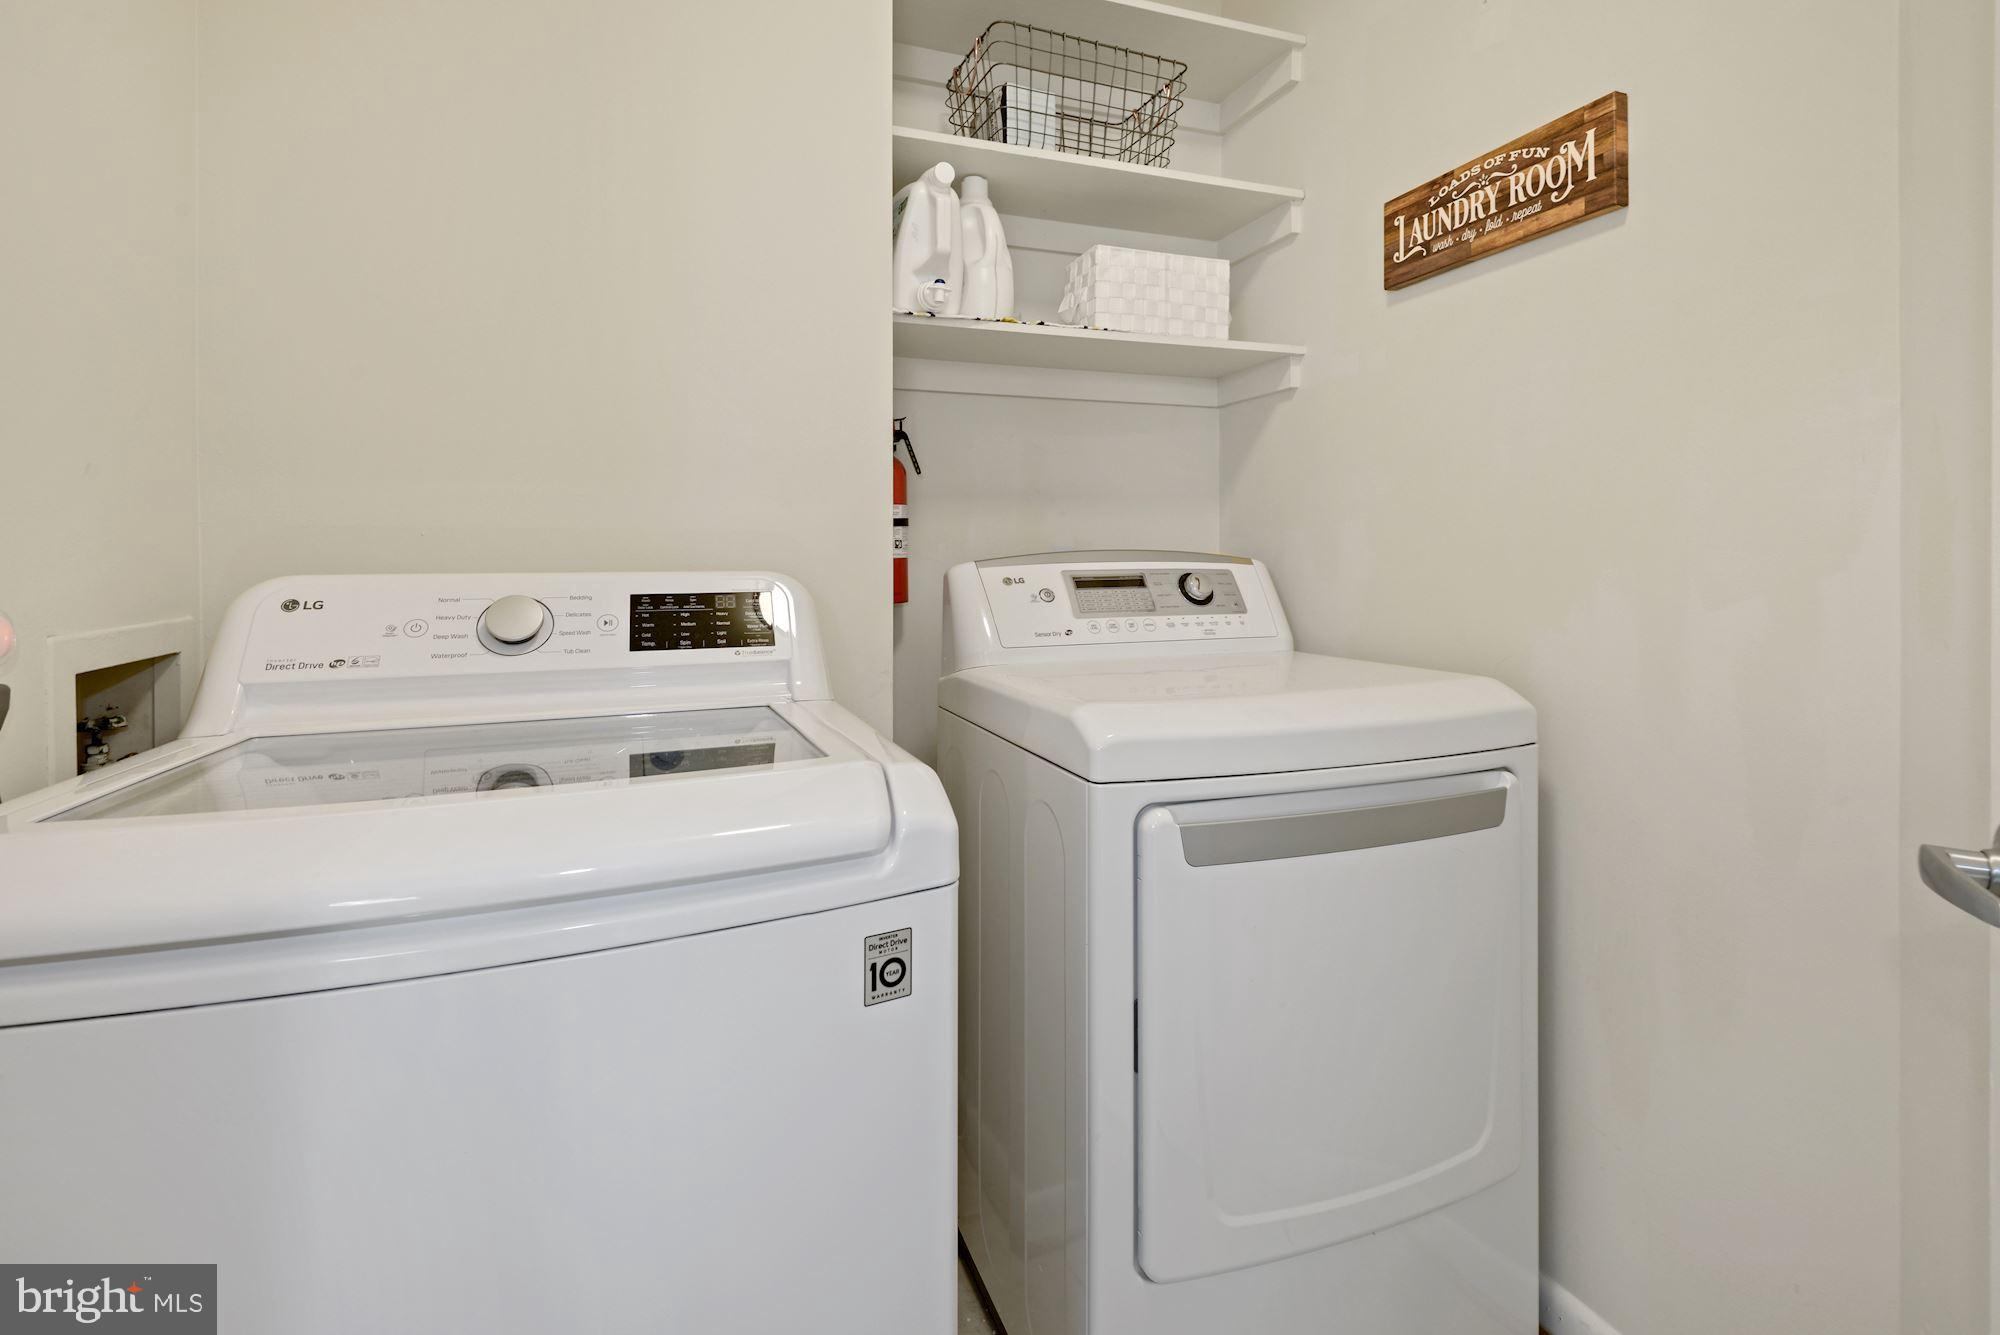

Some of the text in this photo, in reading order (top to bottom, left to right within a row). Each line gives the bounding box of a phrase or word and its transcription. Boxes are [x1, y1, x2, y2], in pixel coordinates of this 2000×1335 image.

[1428, 147, 1550, 207] LOADS OF FUN
[1393, 127, 1598, 263] LAUNDRY ROOM
[1432, 200, 1543, 253] wash dry fold repeat
[303, 600, 324, 610] LG
[265, 662, 324, 671] Direct Drive
[879, 933, 898, 941] INVERTER
[868, 938, 908, 952] Direct Drive
[879, 946, 898, 954] MOTOR
[869, 957, 907, 992] 10
[886, 968, 900, 977] YEAR
[871, 988, 905, 1000] WARRANTY
